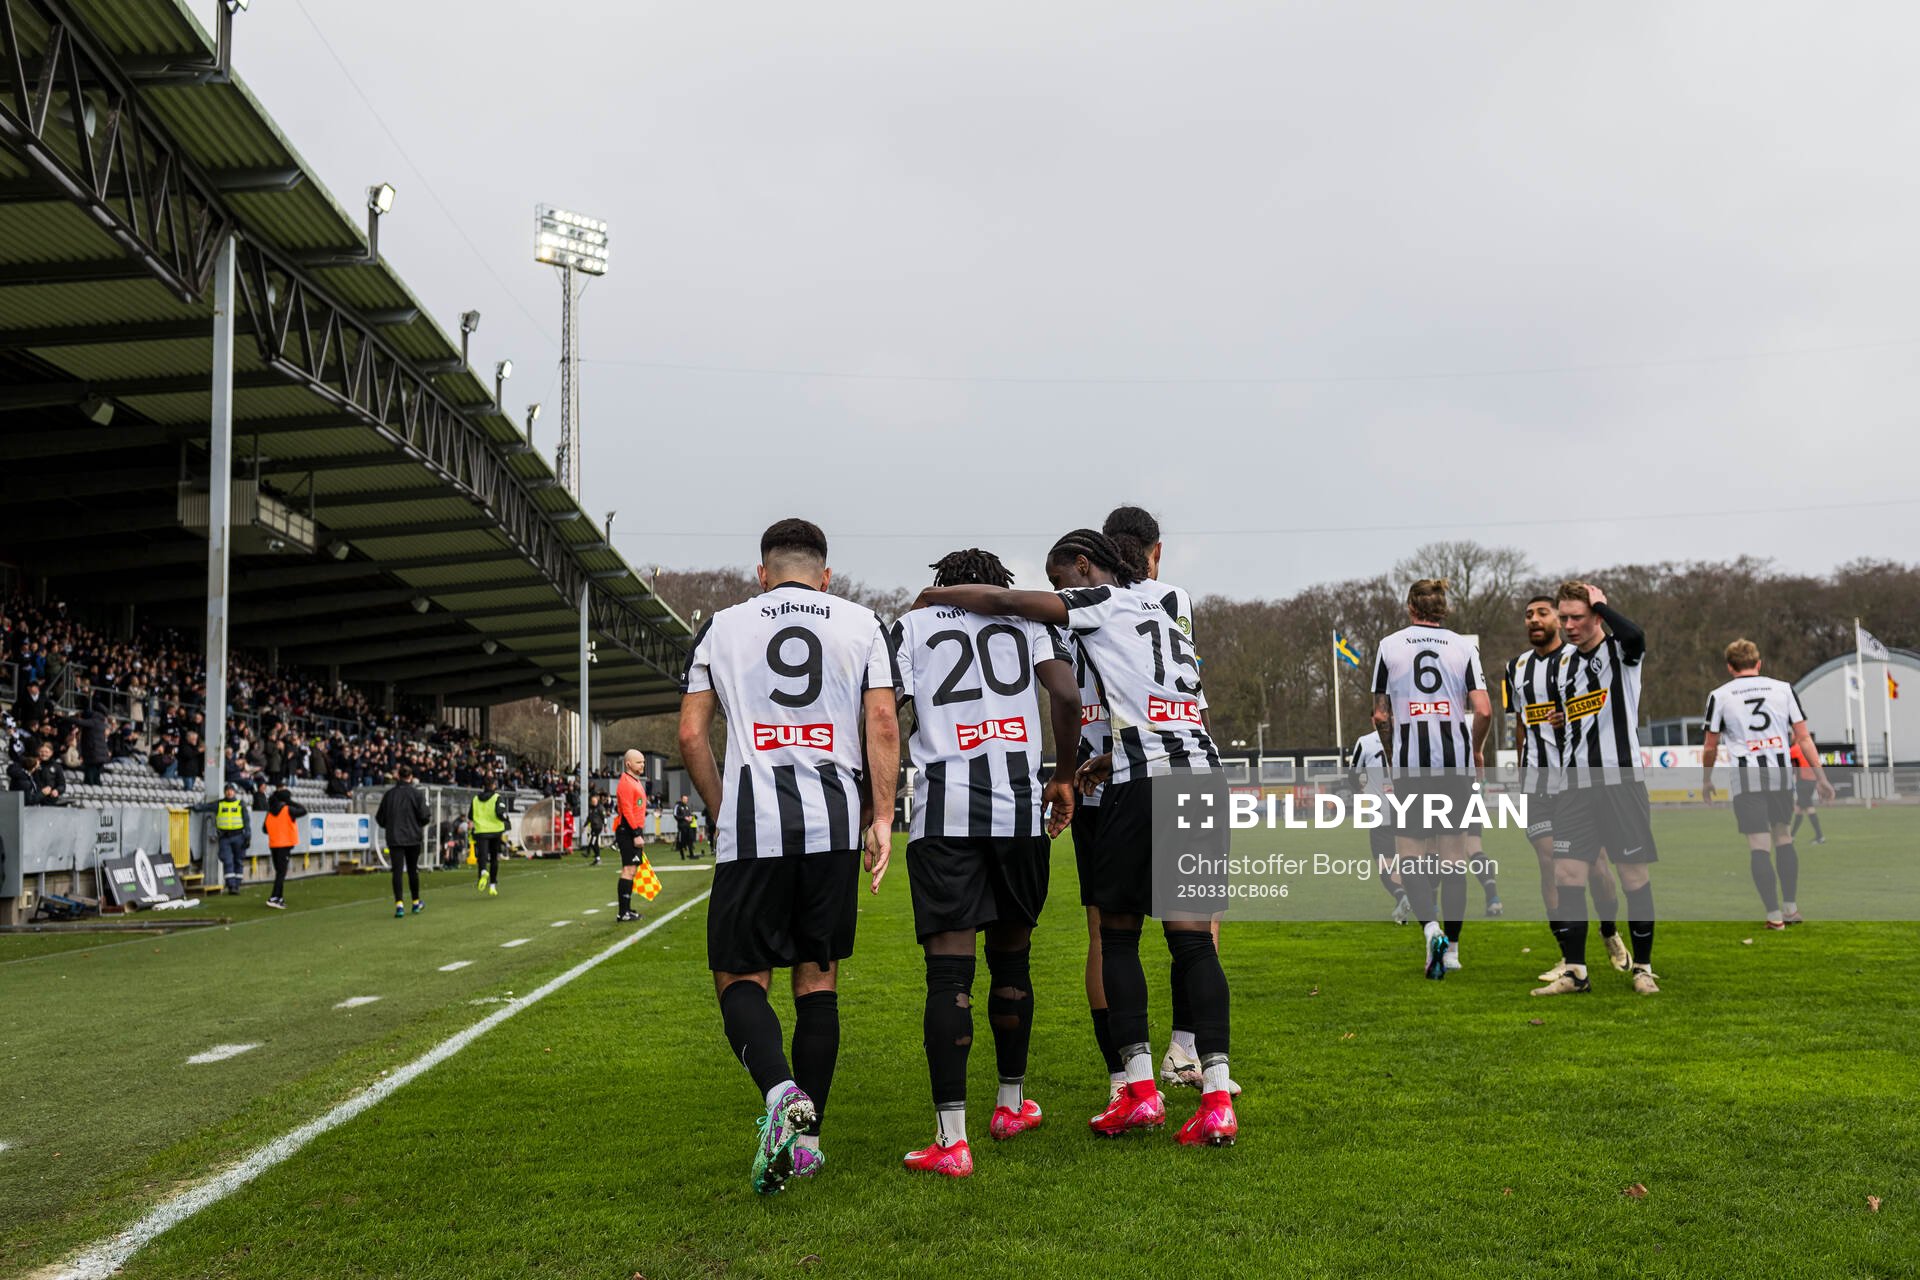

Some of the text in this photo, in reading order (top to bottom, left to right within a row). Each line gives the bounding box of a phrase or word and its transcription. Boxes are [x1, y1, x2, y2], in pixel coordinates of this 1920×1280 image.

[767, 626, 822, 708] 9
[926, 623, 1030, 706] 20
[1135, 620, 1202, 696] 15
[1413, 650, 1443, 694] 6
[1150, 701, 1200, 721] PULS
[1410, 703, 1449, 714] PULS
[1744, 698, 1771, 731] 3
[757, 727, 832, 746] PULS
[960, 720, 1025, 747] PULS
